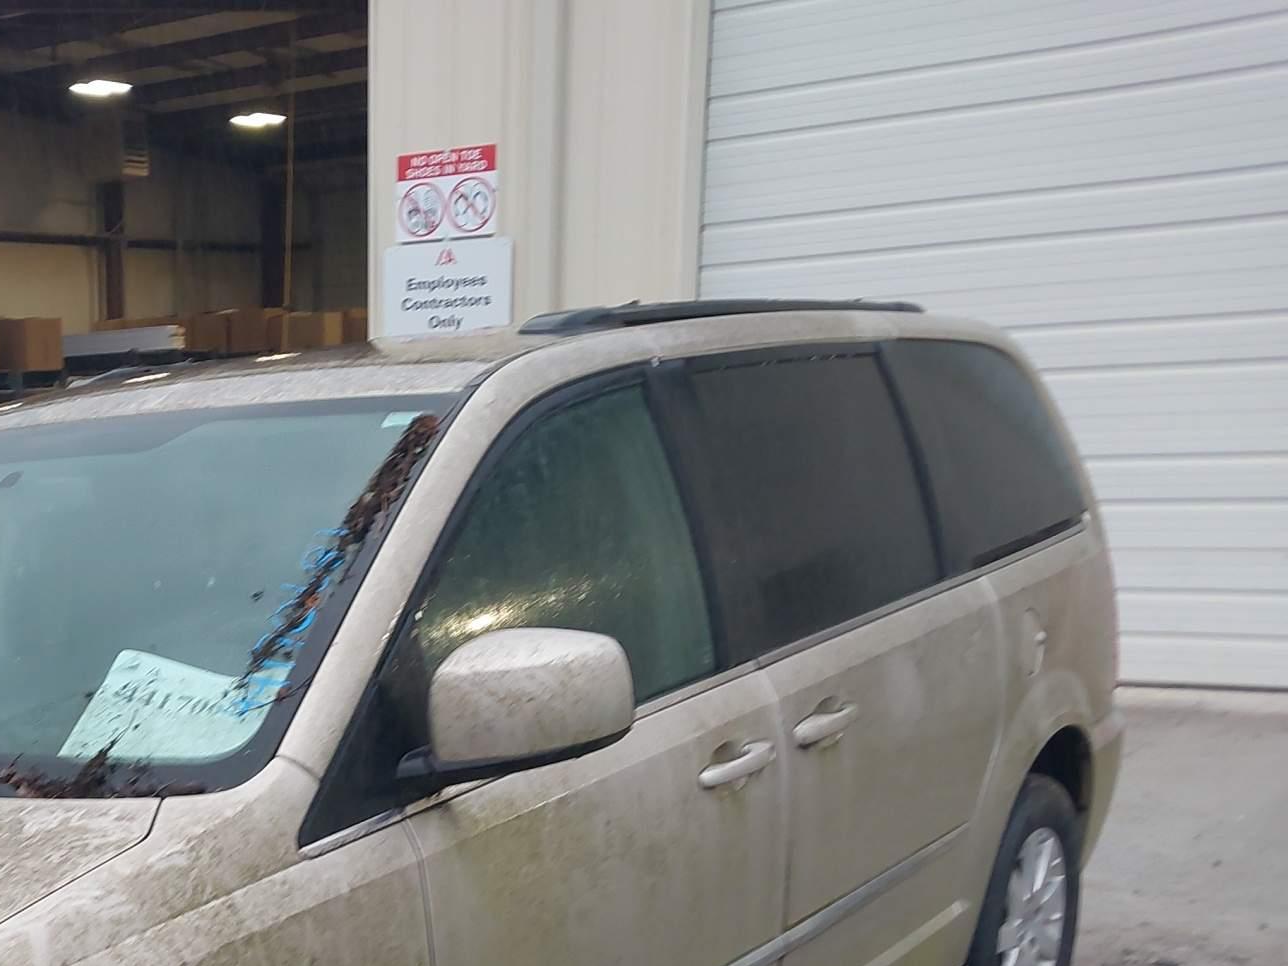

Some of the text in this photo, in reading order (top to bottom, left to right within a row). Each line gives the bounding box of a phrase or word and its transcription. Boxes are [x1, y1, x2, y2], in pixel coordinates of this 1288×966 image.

[410, 148, 483, 167] NO OPEN TOE
[406, 275, 488, 292] Employees
[401, 296, 492, 311] Contractors
[428, 314, 464, 331] Only
